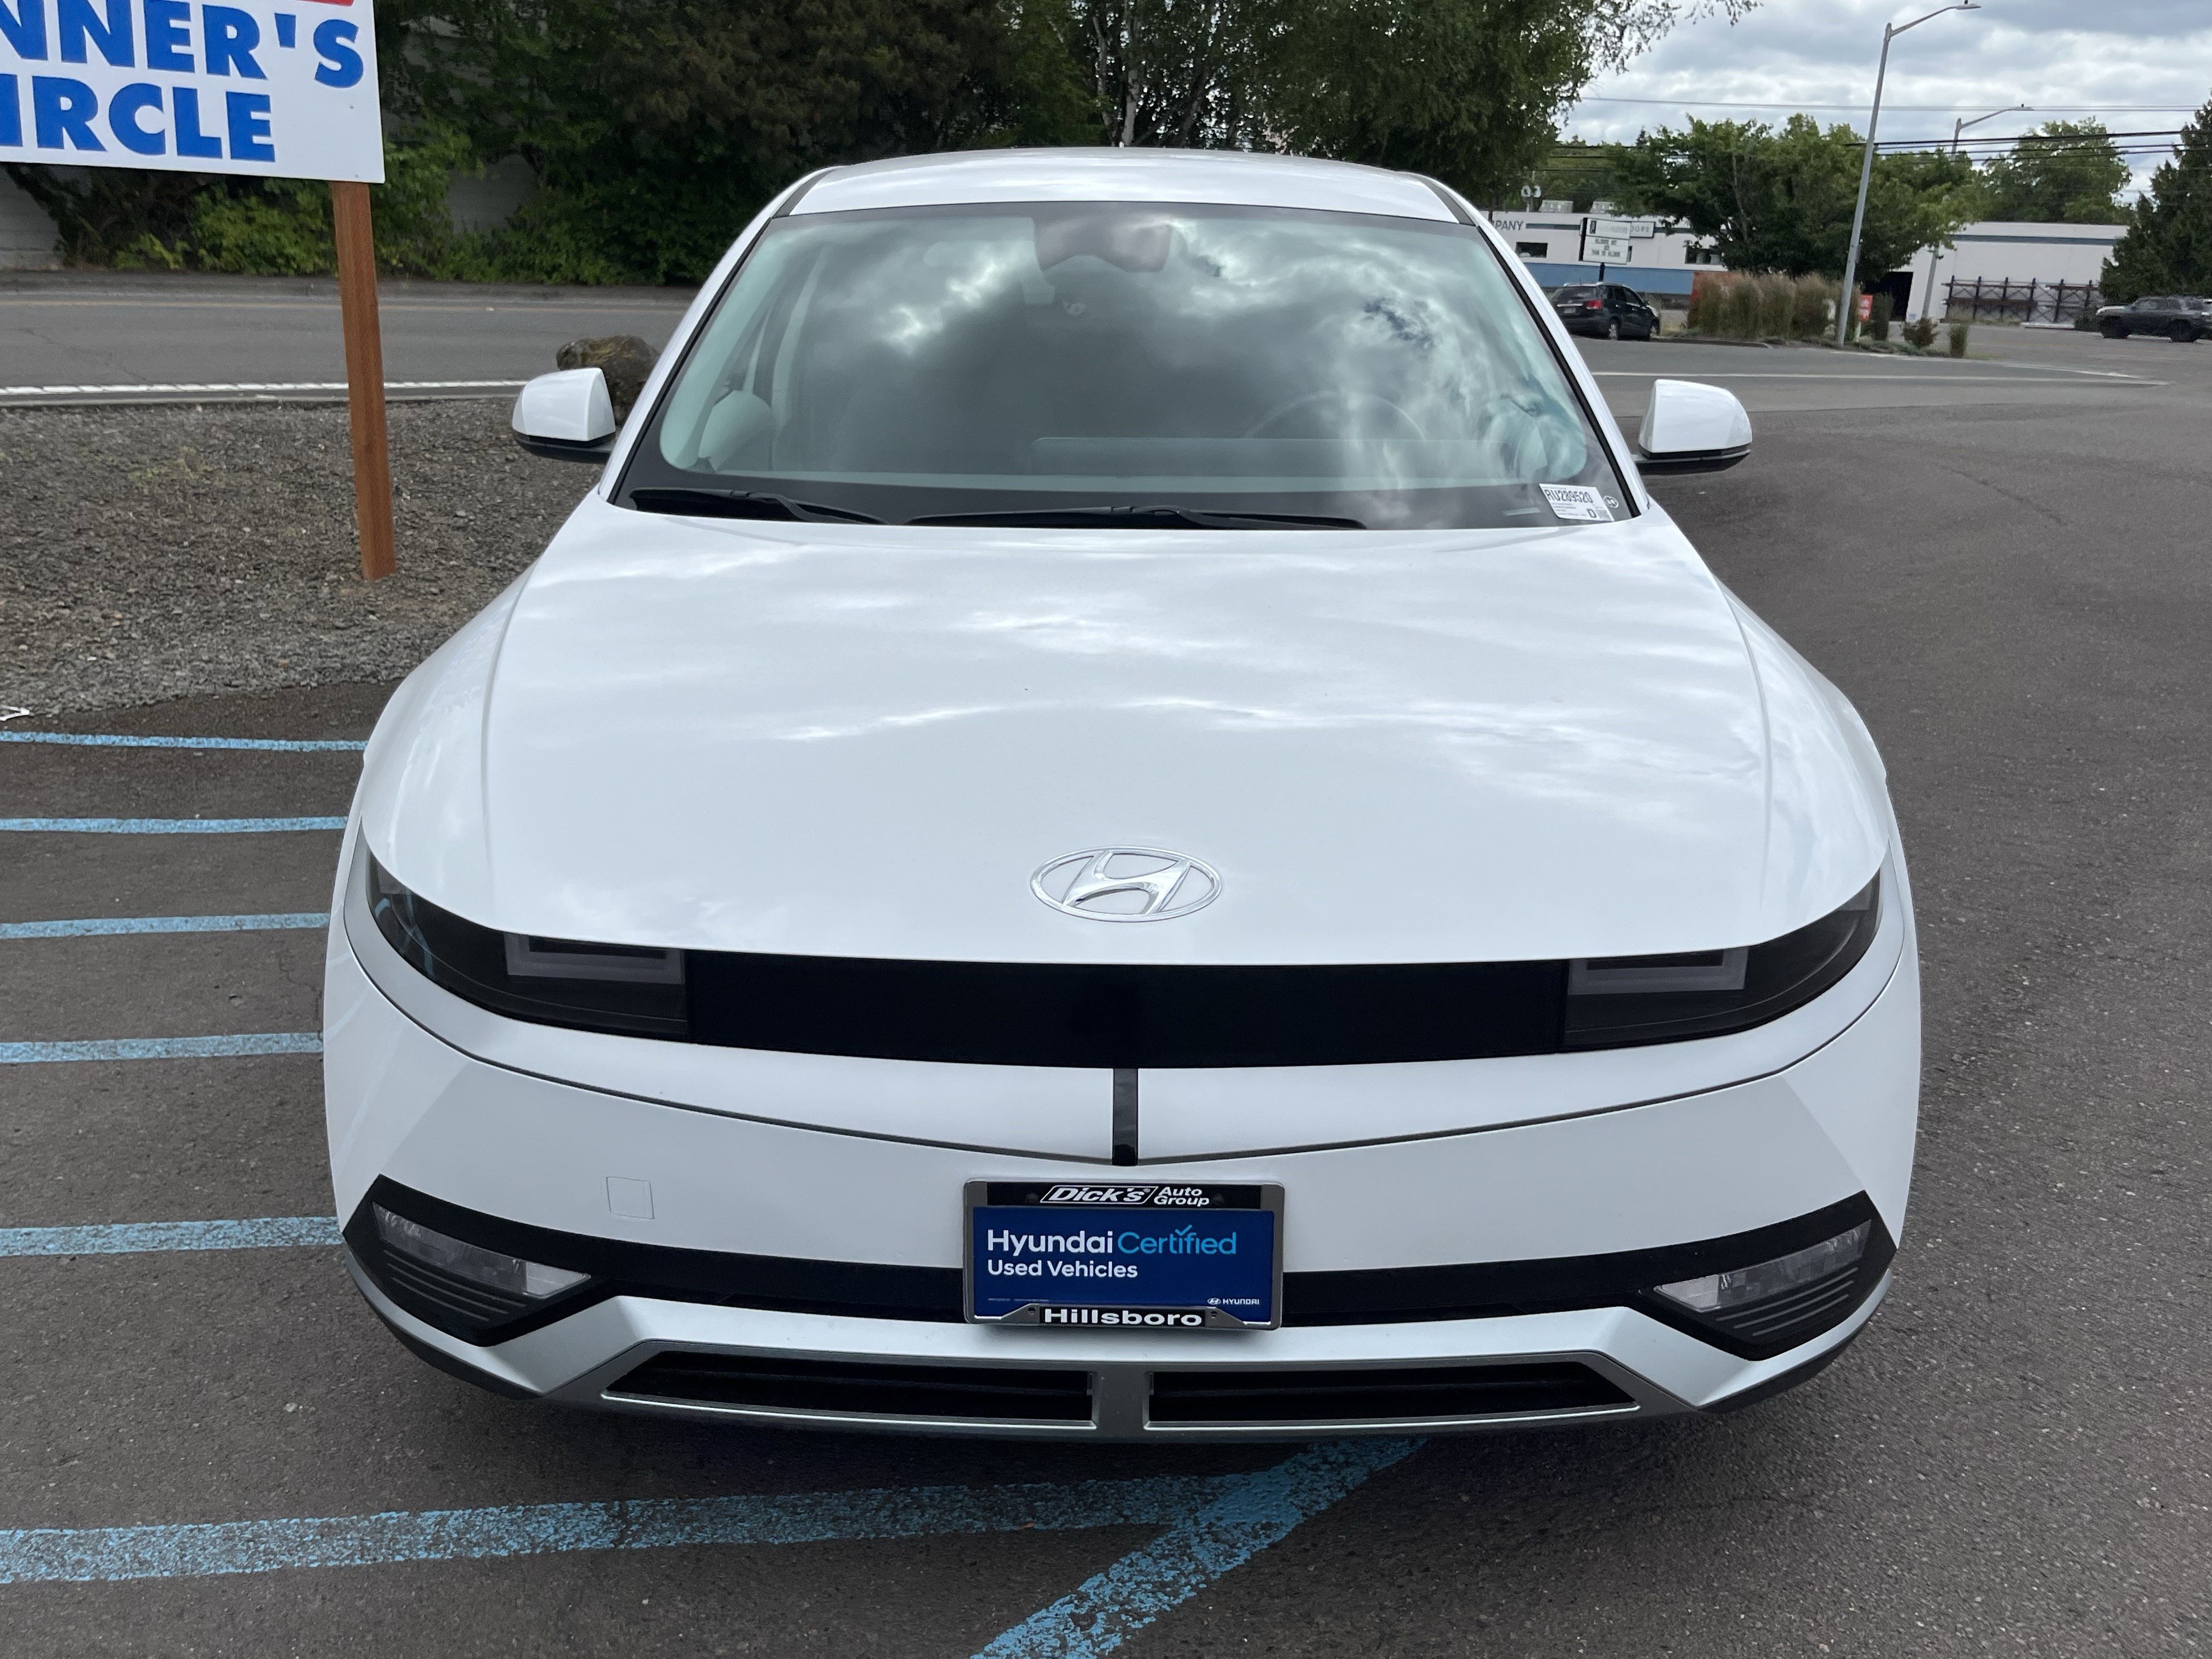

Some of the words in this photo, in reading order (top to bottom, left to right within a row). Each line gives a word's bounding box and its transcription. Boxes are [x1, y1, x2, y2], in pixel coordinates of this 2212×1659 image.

[0, 74, 275, 162] IRCLE
[1489, 220, 1523, 230] PANY
[1544, 489, 1593, 503] RU289520
[1587, 509, 1597, 518] D
[1158, 1186, 1202, 1197] Auto
[1154, 1195, 1210, 1206] Group
[988, 1229, 1113, 1256] Hyundai
[1118, 1224, 1236, 1254] Certified
[988, 1260, 1042, 1276] Used
[1048, 1260, 1138, 1278] Vehicles
[1045, 1308, 1203, 1326] Hillsboro
